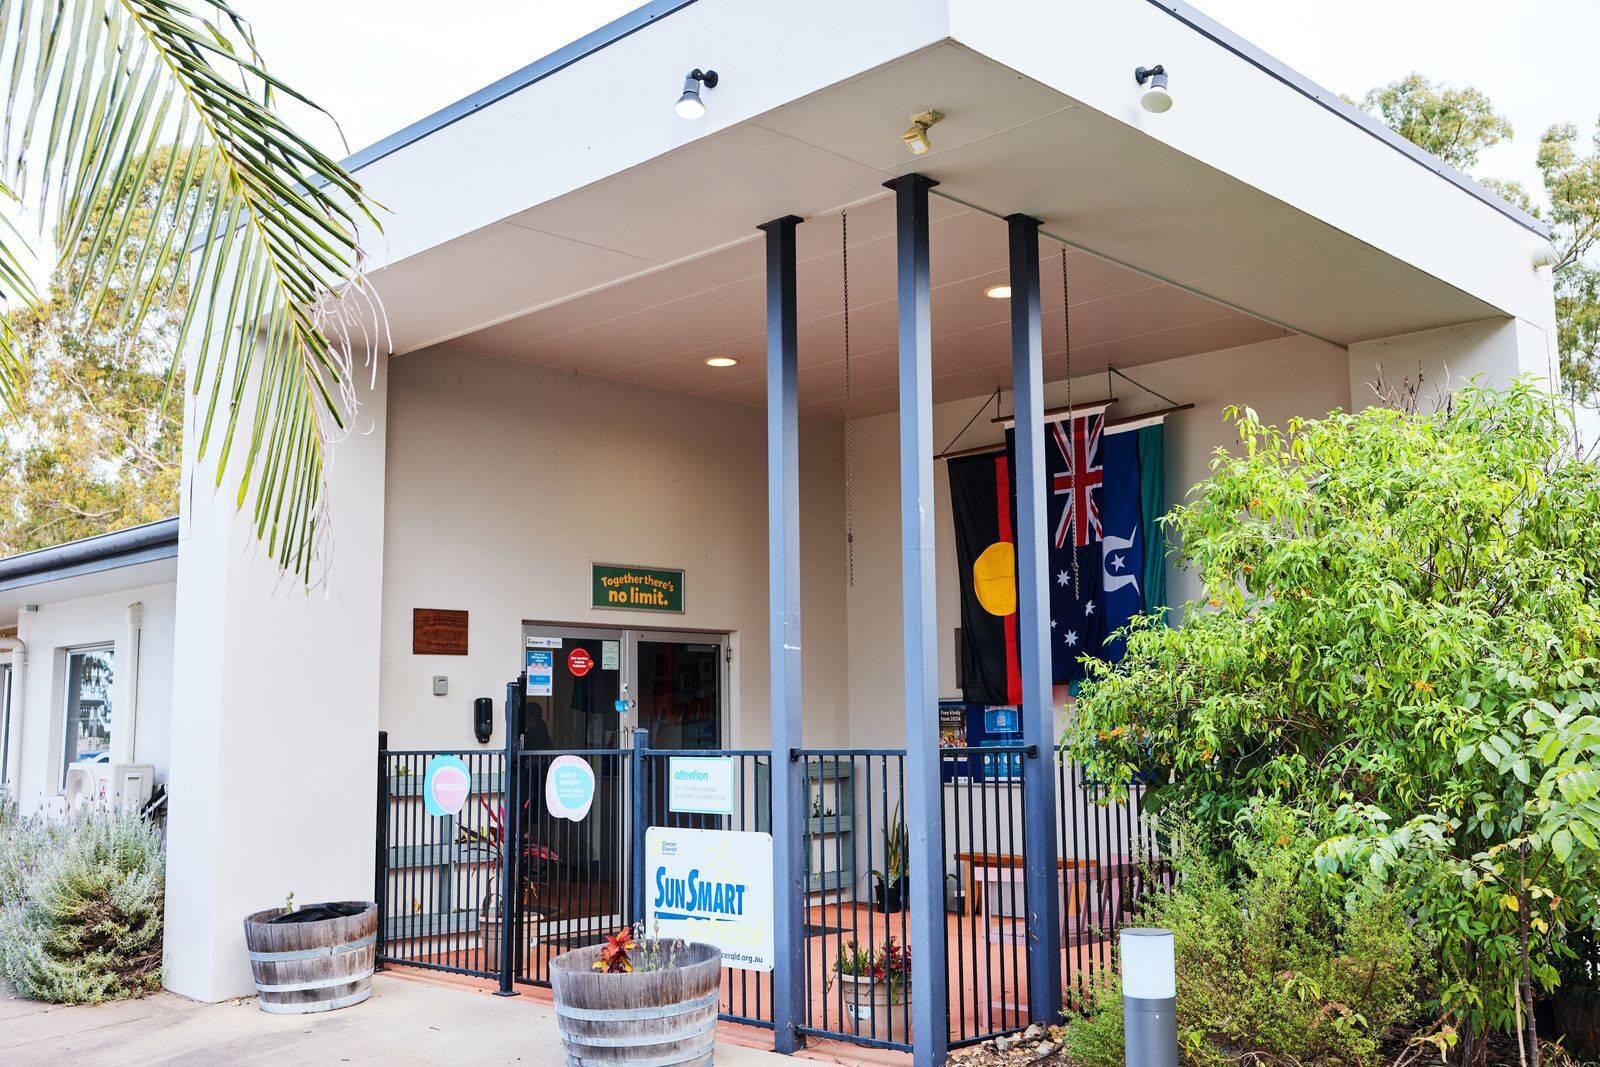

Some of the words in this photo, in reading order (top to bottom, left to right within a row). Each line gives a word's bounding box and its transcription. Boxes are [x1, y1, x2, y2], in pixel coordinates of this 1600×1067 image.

[601, 573, 643, 588] Together
[644, 575, 675, 592] there's
[608, 590, 627, 603] no
[630, 587, 669, 606] limit.
[675, 769, 709, 780] attention
[435, 781, 465, 792] entrance
[720, 952, 763, 964] cerqld.org.au
